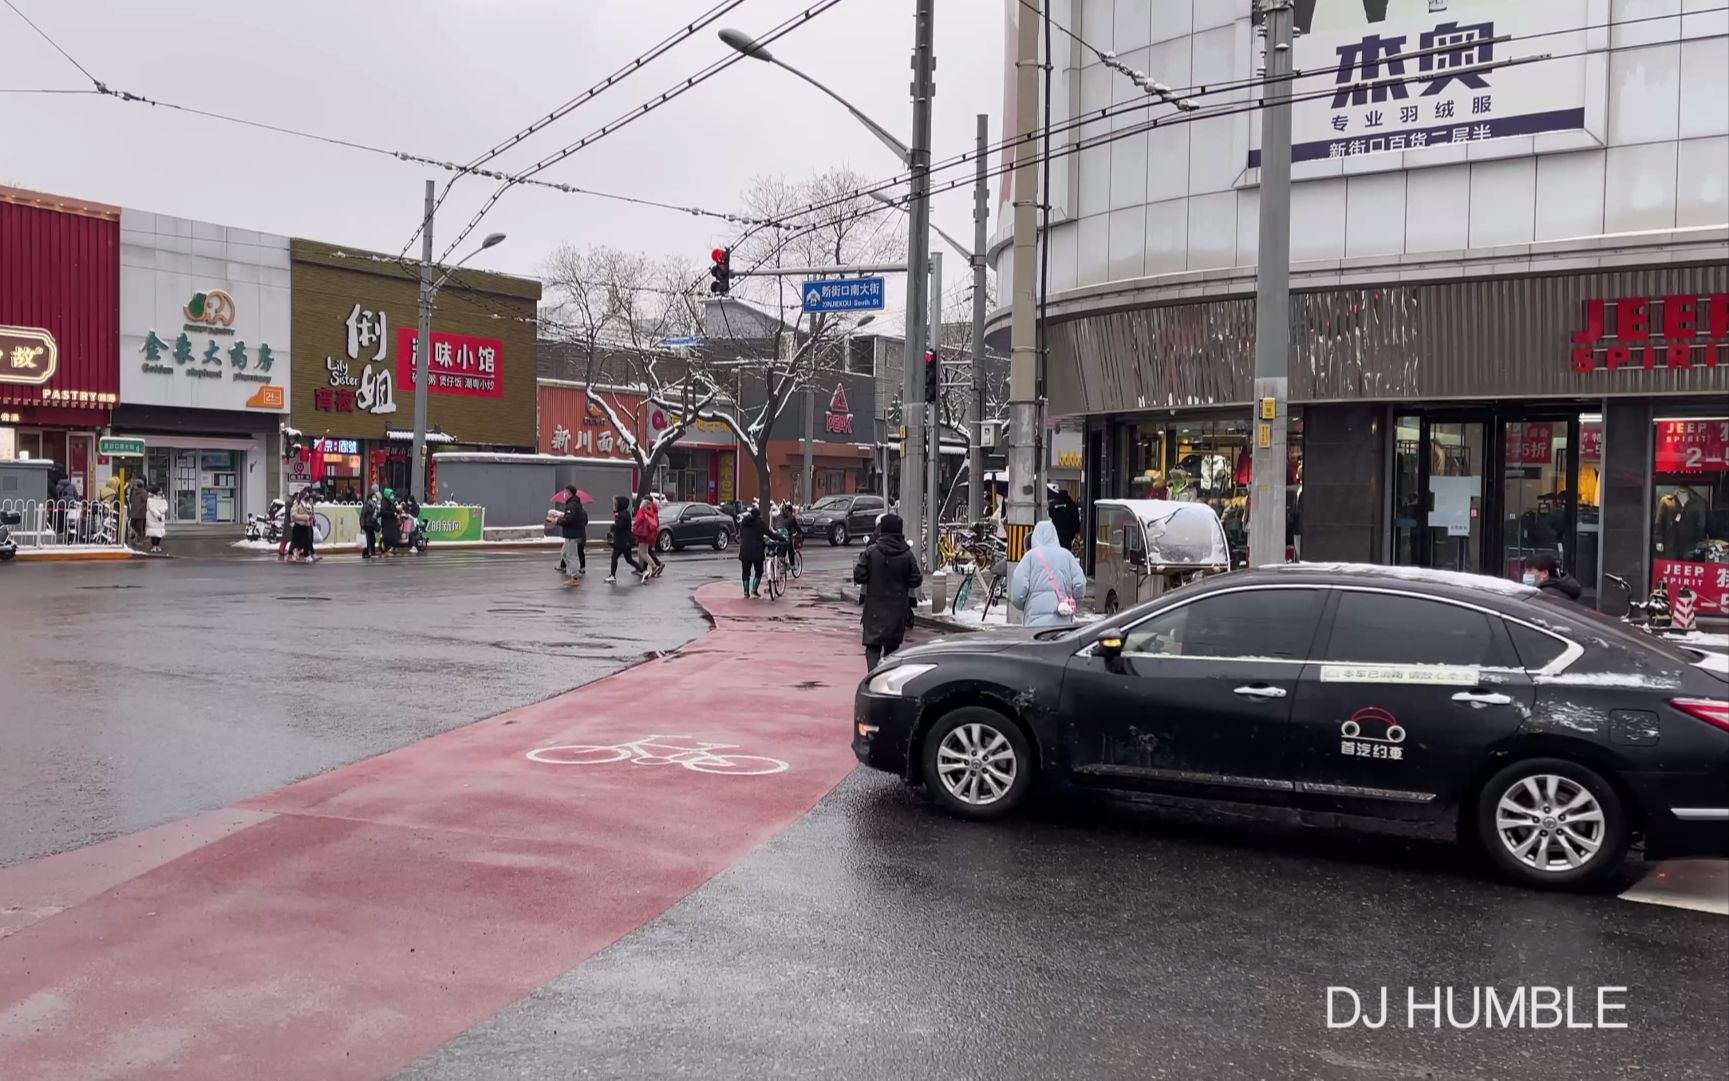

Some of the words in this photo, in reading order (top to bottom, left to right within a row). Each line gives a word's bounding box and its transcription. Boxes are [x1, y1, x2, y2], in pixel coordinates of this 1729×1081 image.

[1331, 21, 1495, 109] 杰奥
[1331, 96, 1492, 132] 专业羽绒服
[1329, 124, 1492, 159] 新街口百货二层半
[821, 282, 880, 298] 新街口南大街
[139, 329, 275, 373] 金象大药房
[327, 356, 348, 373] Lily
[330, 370, 359, 387] Sister
[42, 388, 97, 402] PASTRY
[826, 411, 853, 433] PEAK
[1666, 422, 1707, 434] JEEP
[1665, 435, 1706, 443] SPIRIT
[1663, 563, 1705, 577] JEEP
[1662, 576, 1703, 587] SPIRIT
